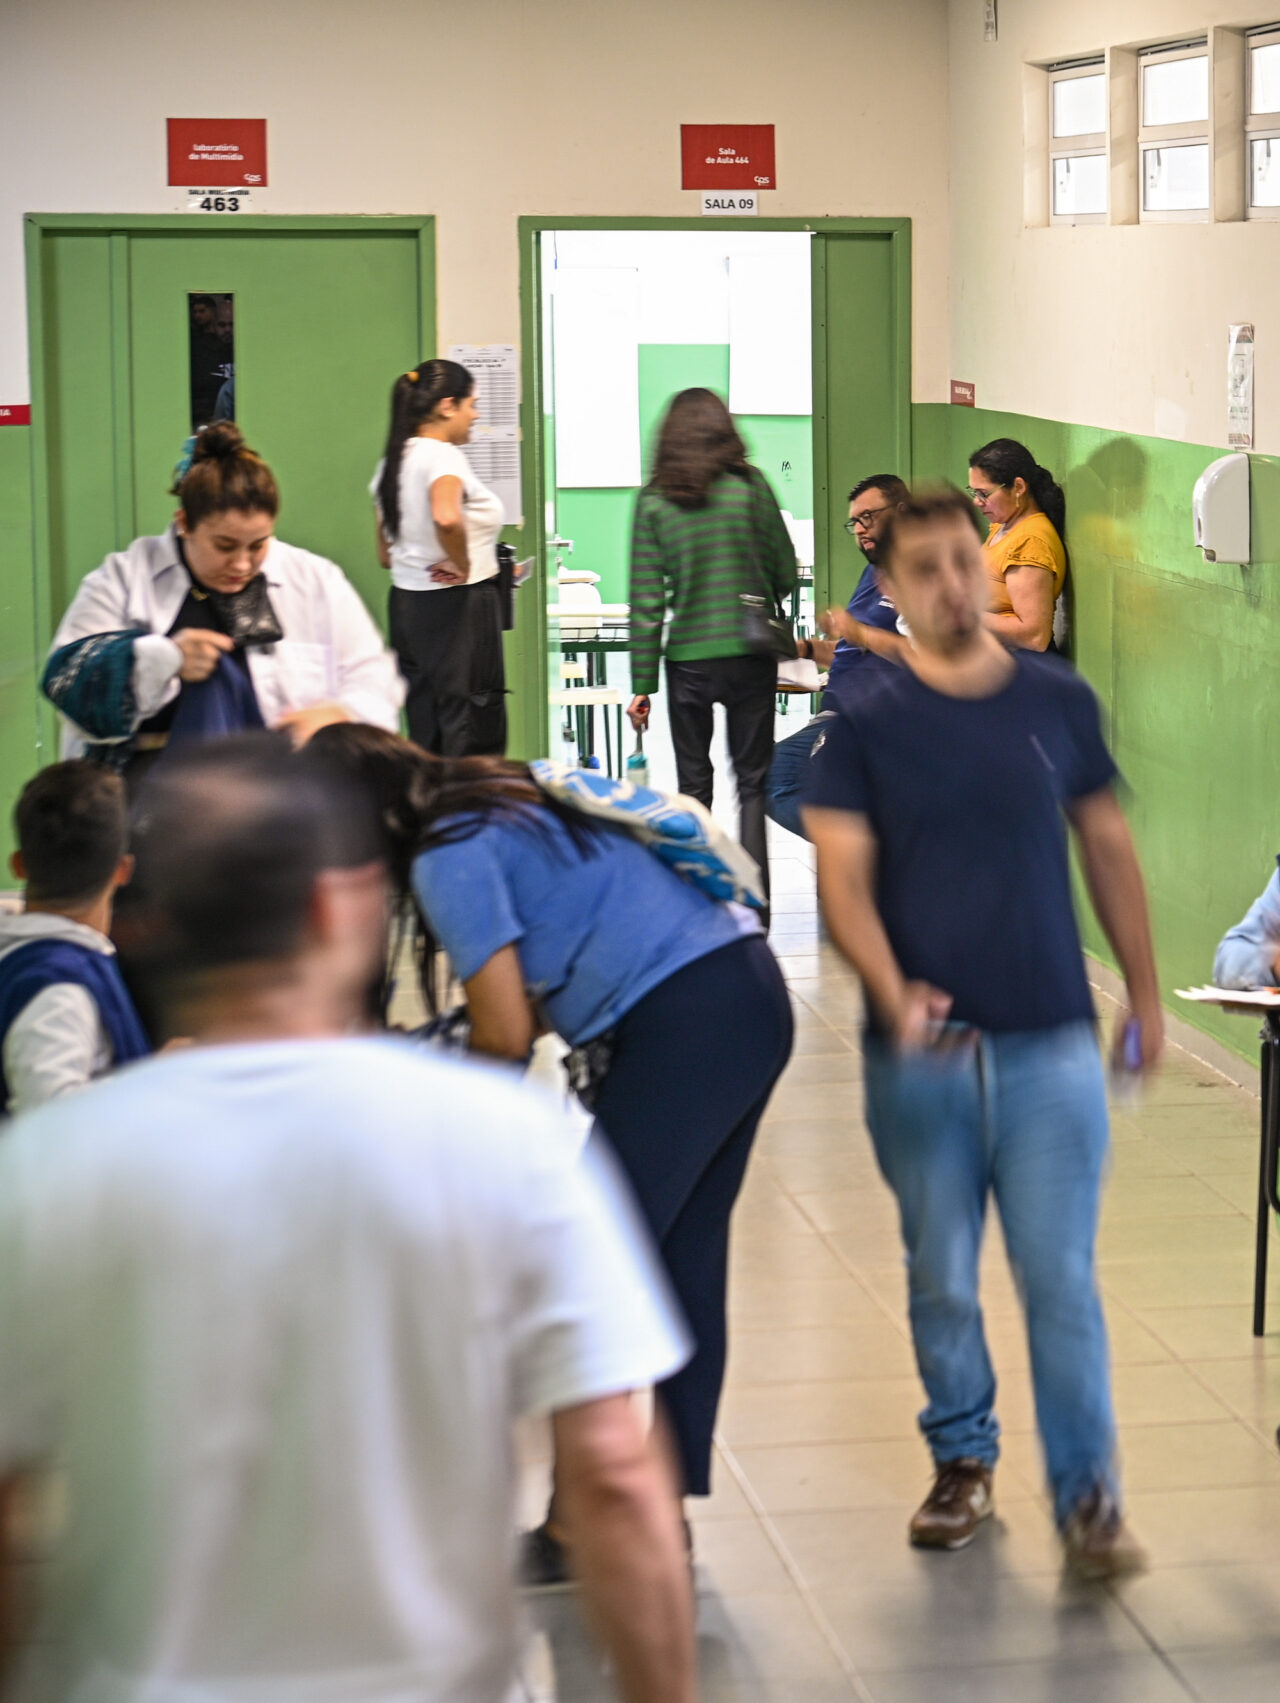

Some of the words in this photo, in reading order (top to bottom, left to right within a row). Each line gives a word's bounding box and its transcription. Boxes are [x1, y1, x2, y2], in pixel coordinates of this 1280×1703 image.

[200, 197, 239, 211] 463
[705, 199, 736, 209] SALA
[738, 199, 754, 209] 09
